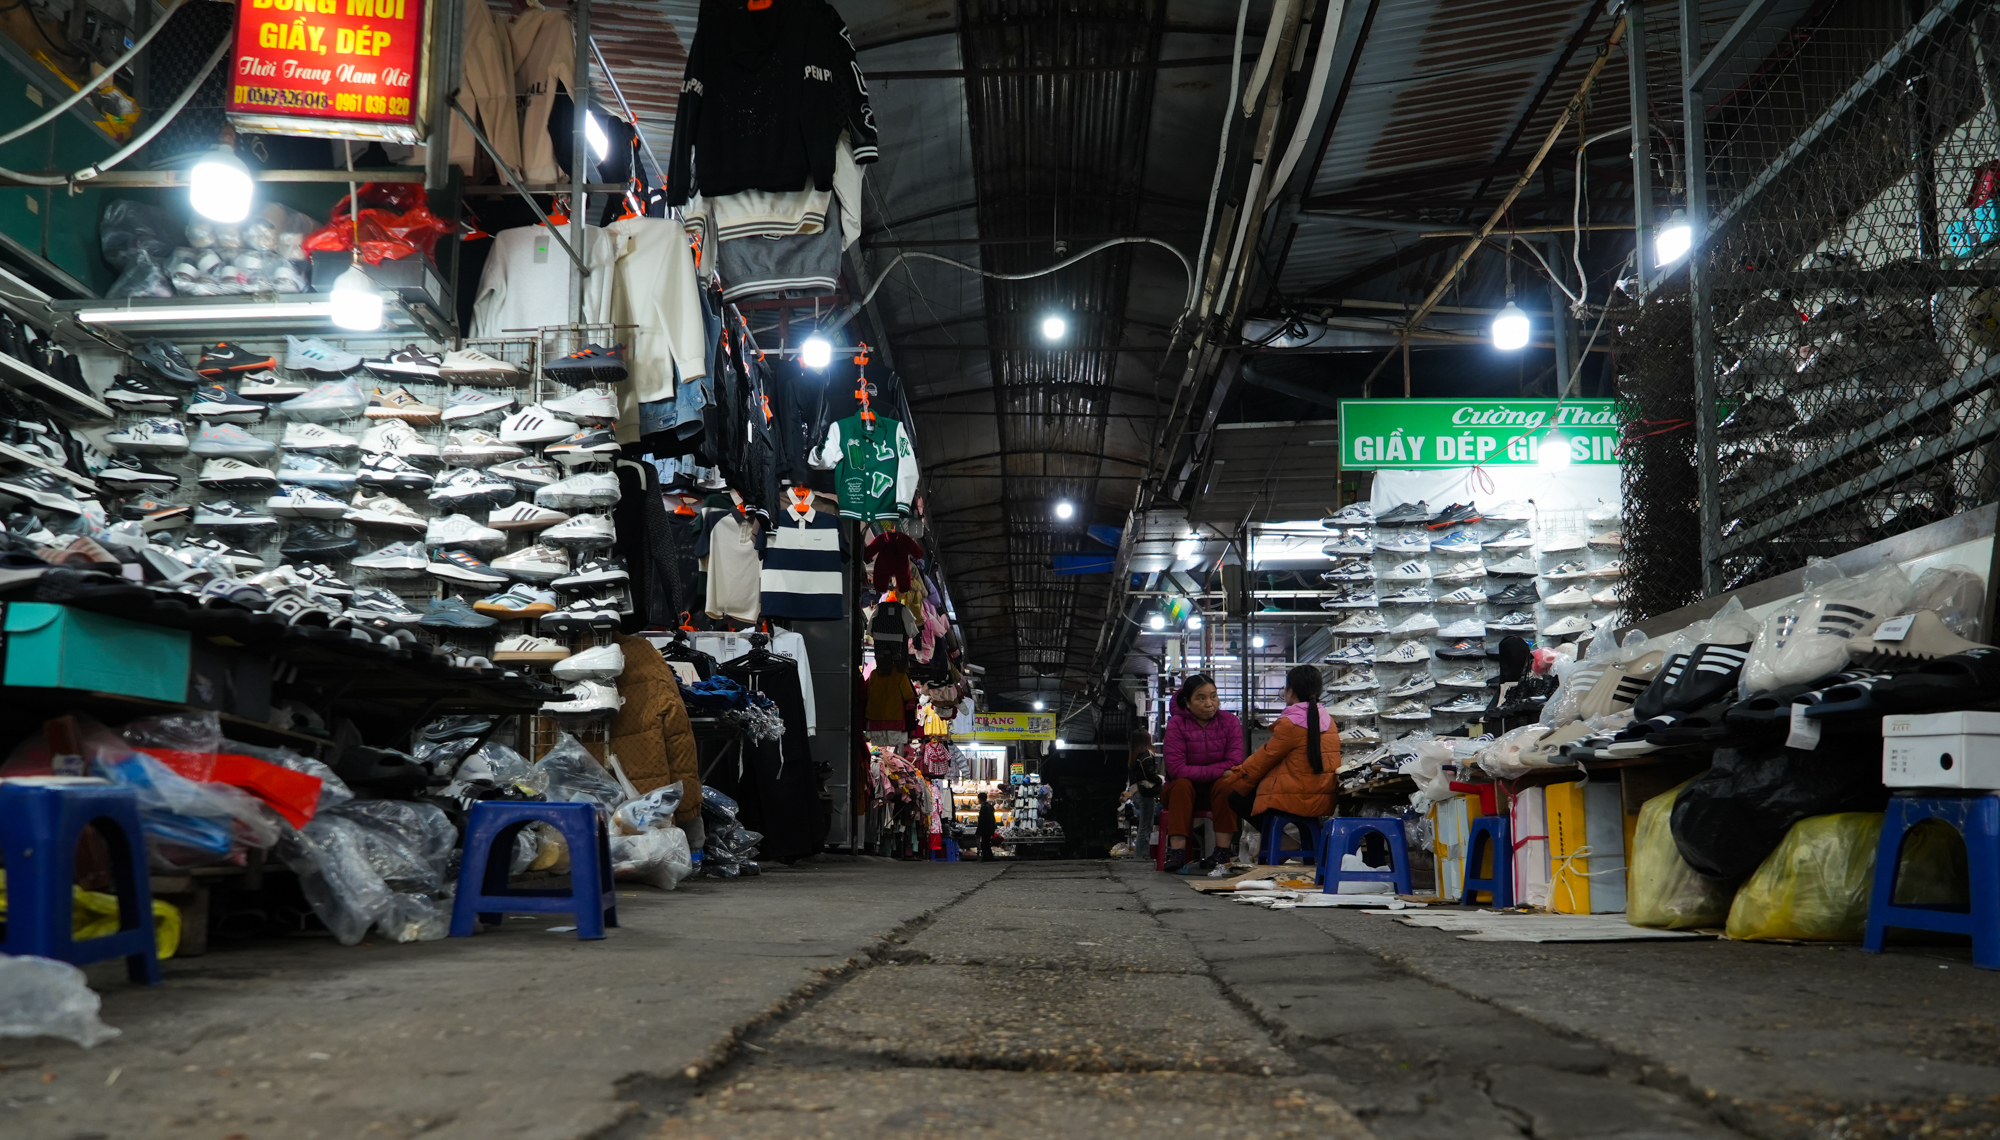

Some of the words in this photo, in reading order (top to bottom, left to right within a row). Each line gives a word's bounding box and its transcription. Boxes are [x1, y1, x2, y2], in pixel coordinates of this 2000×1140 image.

[259, 16, 327, 56] GIẦY,
[336, 25, 392, 57] DÉP
[238, 56, 276, 78] Thời
[282, 59, 332, 86] Trang
[336, 63, 378, 85] Nam
[335, 92, 363, 113] 0961
[365, 95, 387, 114] 036
[389, 97, 410, 116] 920
[1452, 405, 1547, 428] Cường
[1354, 427, 1426, 461] GIẦY
[1436, 431, 1497, 461] DÉP
